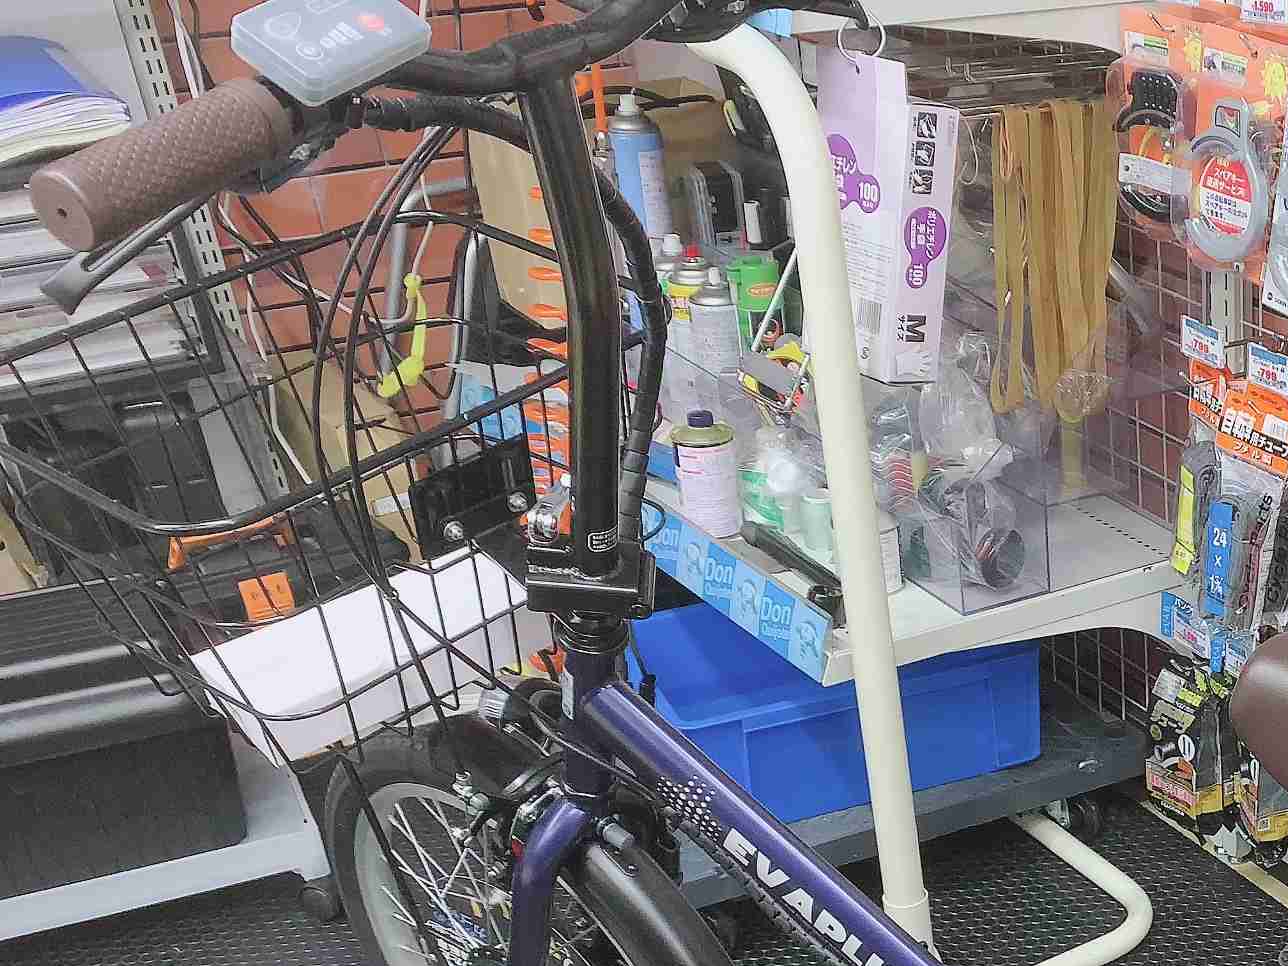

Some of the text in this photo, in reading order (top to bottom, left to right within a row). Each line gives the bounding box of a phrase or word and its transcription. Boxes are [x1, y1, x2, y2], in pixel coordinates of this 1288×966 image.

[858, 182, 880, 201] 100
[905, 314, 927, 343] M
[704, 557, 735, 585] Don
[760, 597, 792, 626] Don
